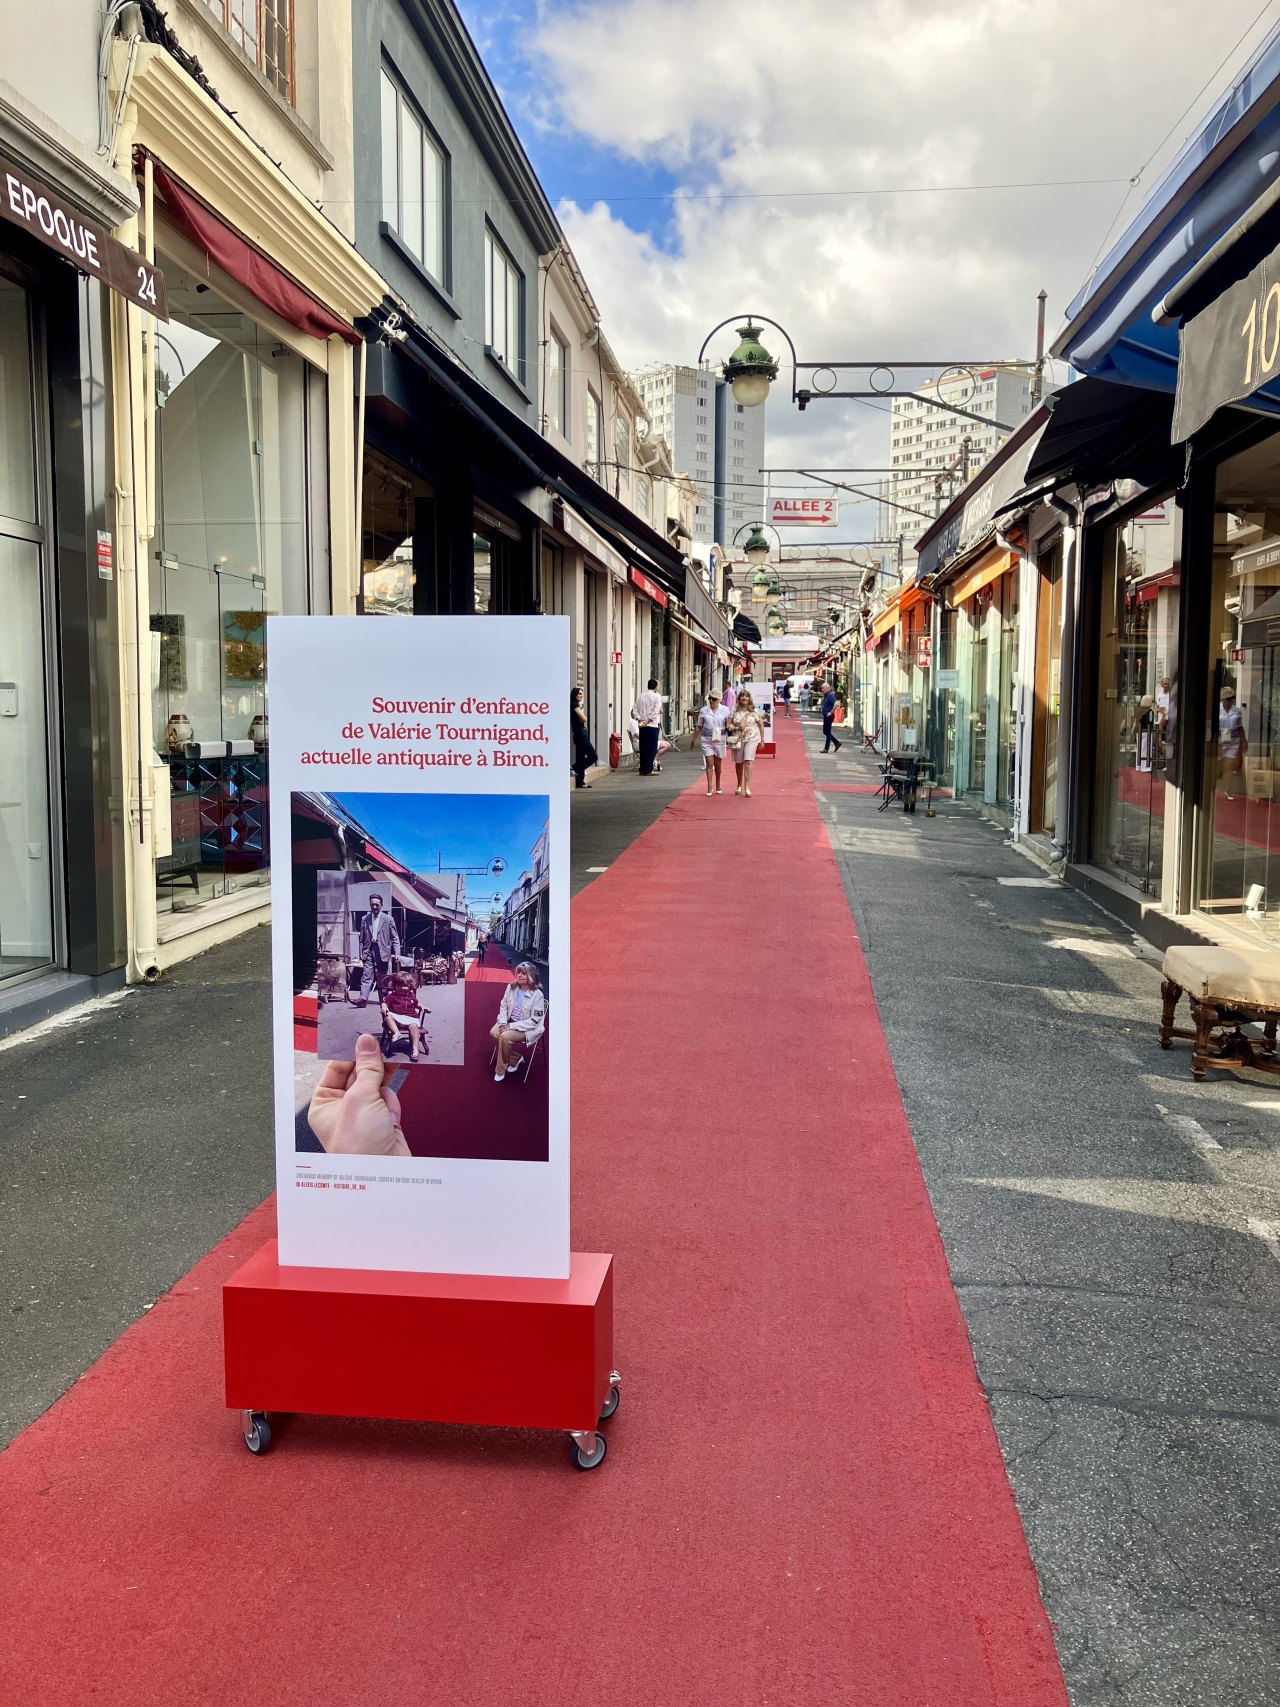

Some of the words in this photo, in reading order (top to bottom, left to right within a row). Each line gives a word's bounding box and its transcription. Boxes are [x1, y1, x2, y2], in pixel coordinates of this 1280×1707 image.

[5, 172, 101, 268] EPOQUE
[137, 266, 156, 305] 24
[773, 500, 820, 511] ALLEE
[824, 501, 833, 511] 2
[372, 696, 455, 714] Souvenir
[459, 697, 549, 715] d’enfance
[341, 722, 364, 739] de
[368, 722, 431, 740] Valérie
[435, 723, 549, 745] Tournigand,
[300, 748, 372, 765] actuelle
[376, 748, 472, 769] antiquaire
[477, 749, 488, 766] à
[492, 750, 549, 767] Biron.
